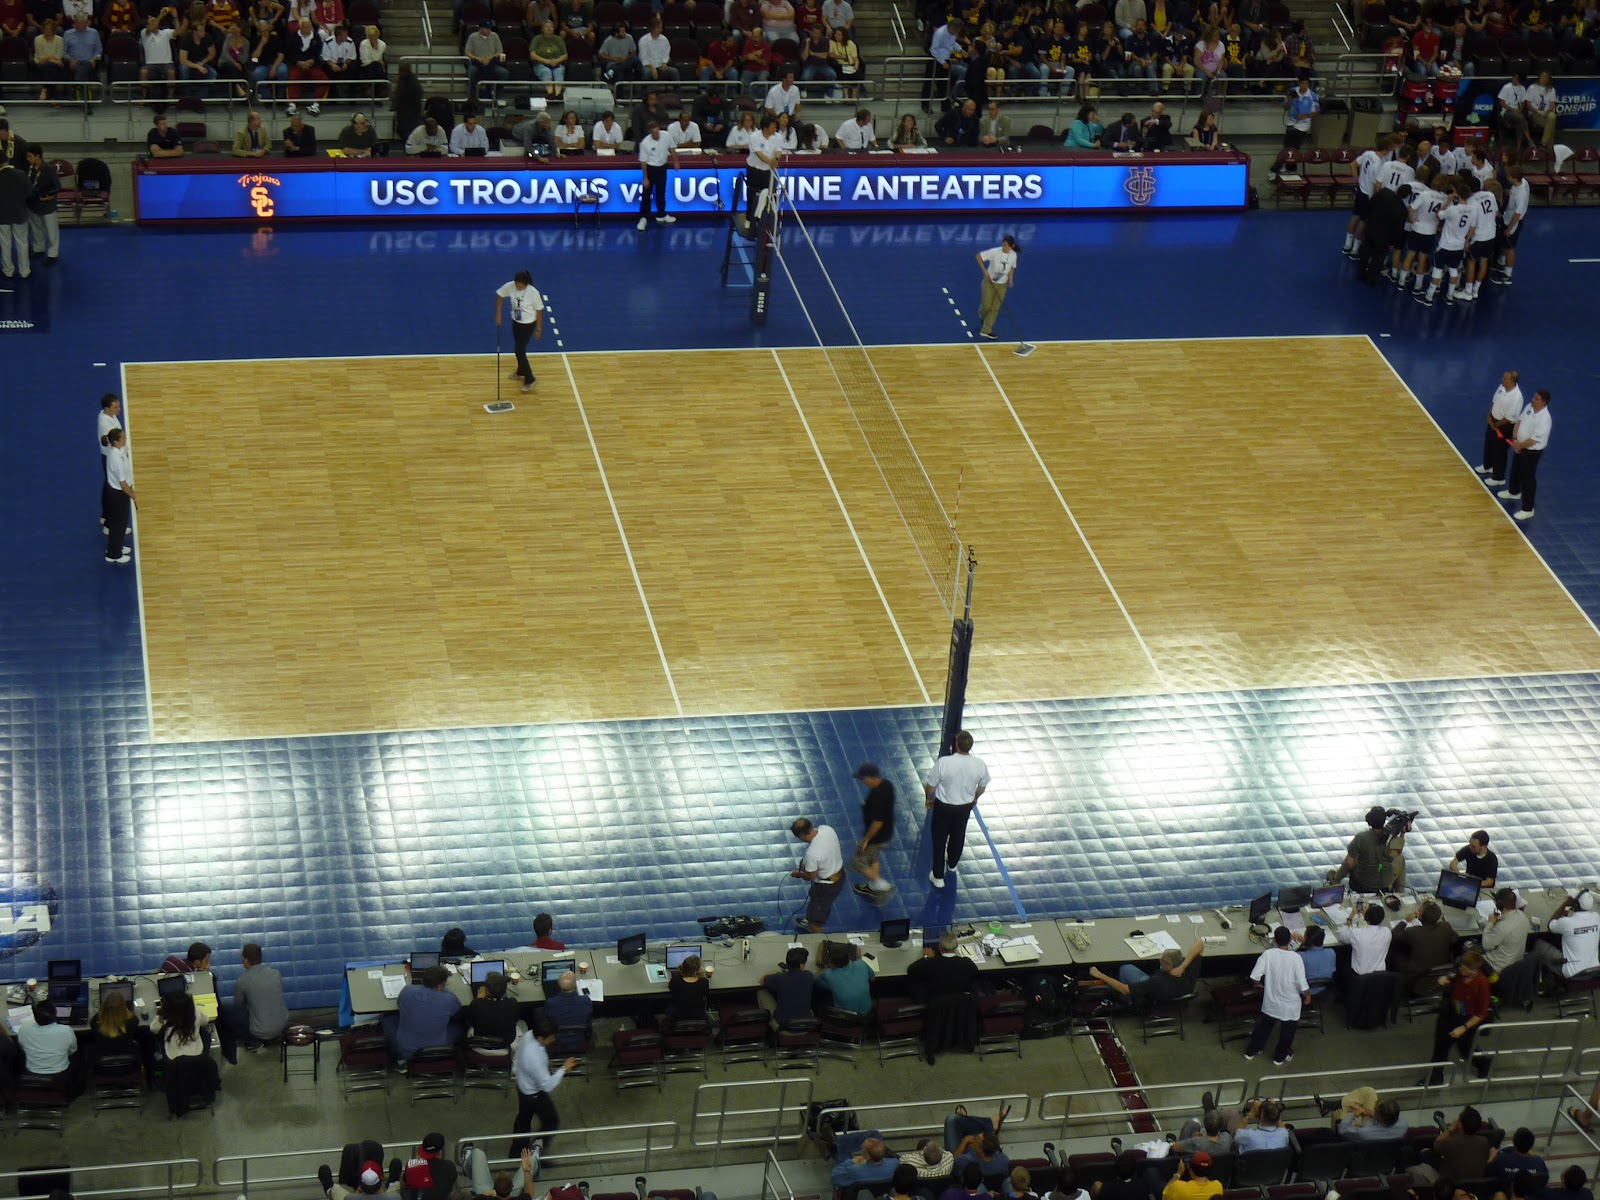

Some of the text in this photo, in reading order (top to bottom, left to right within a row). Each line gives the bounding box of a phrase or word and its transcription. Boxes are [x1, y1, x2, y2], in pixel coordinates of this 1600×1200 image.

[237, 173, 281, 188] Trojans
[370, 179, 439, 206] USC
[450, 177, 609, 205] TROJANS
[674, 176, 720, 202] UC
[852, 174, 1043, 201] ANTEATERS
[1481, 199, 1493, 215] 12
[1458, 214, 1468, 228] 6
[1574, 924, 1599, 935] ESPN
